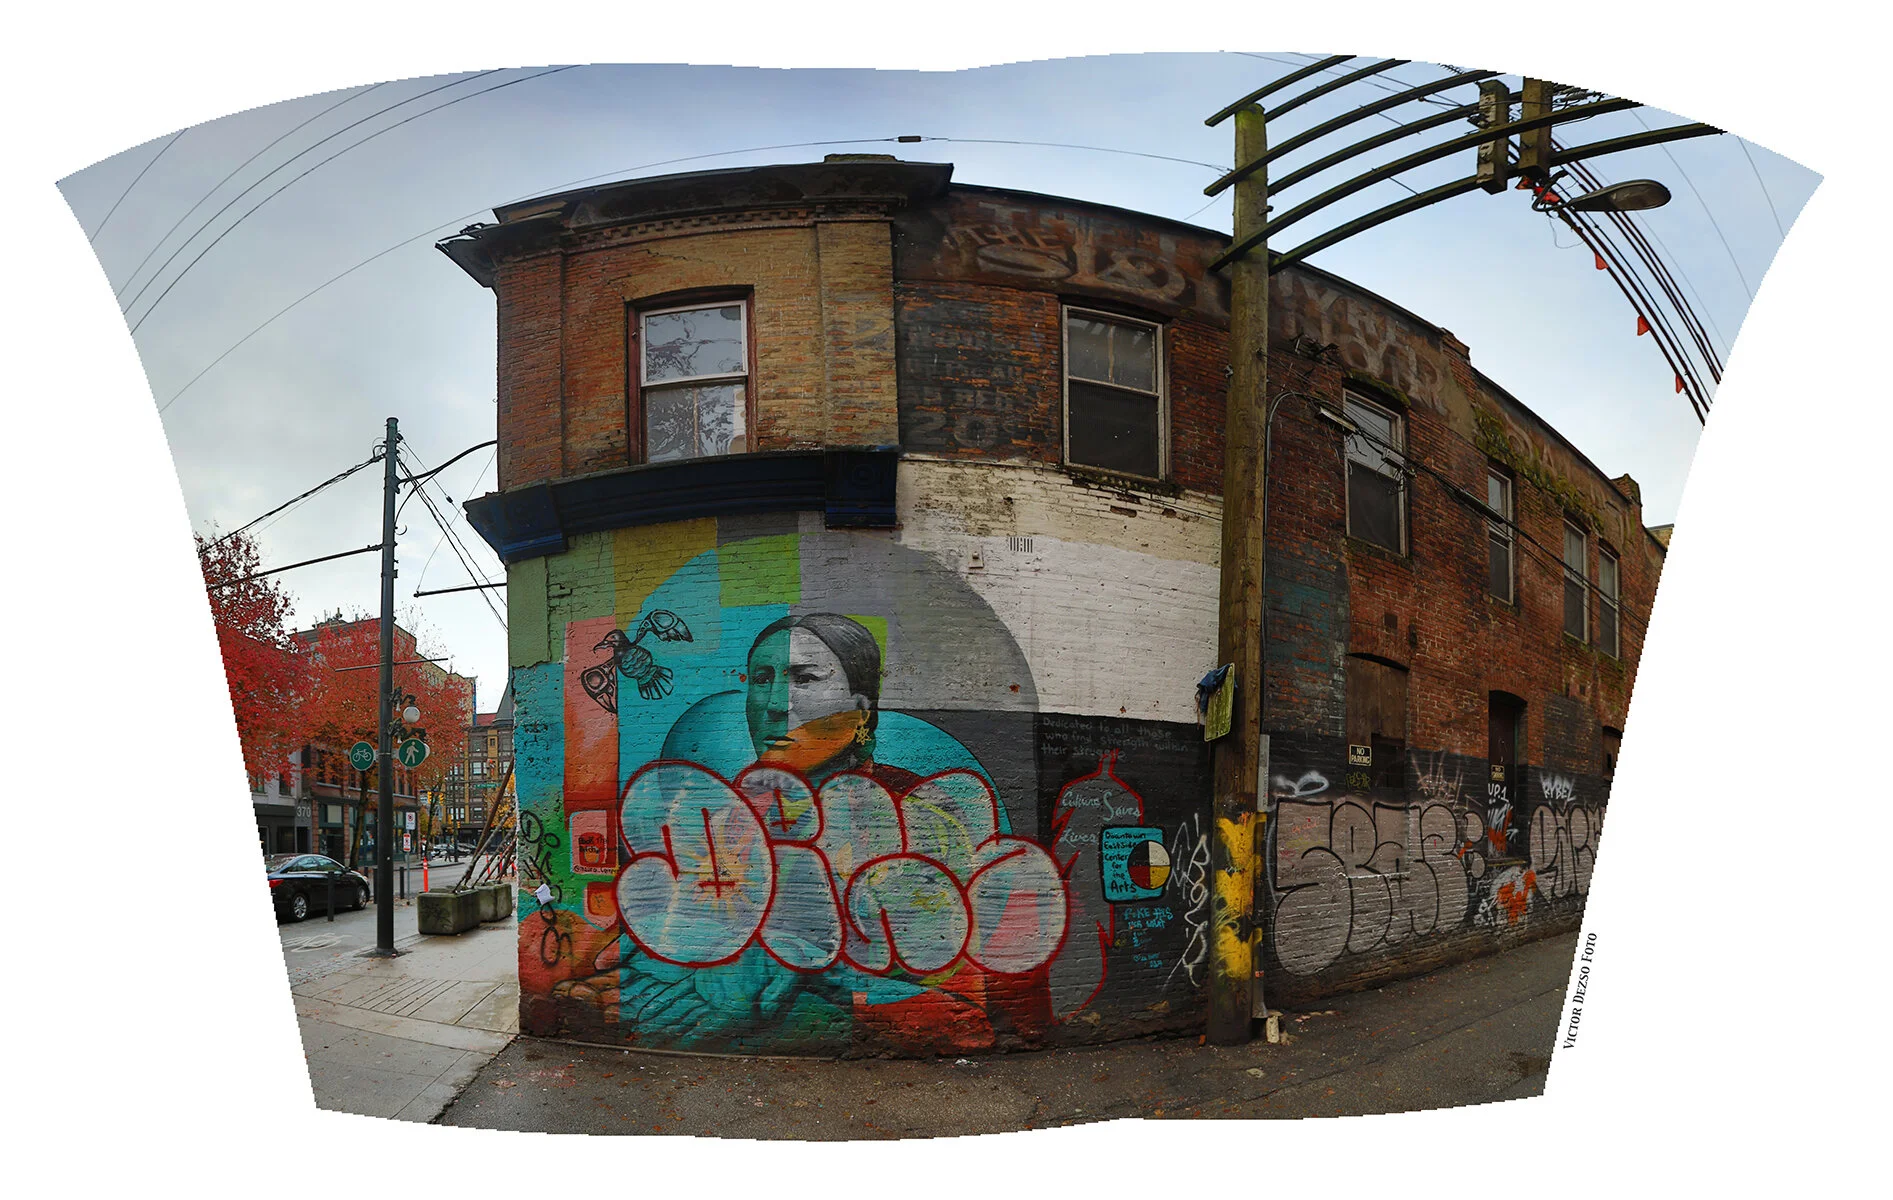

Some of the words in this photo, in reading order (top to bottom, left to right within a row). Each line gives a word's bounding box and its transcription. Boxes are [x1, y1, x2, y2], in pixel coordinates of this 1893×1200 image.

[1042, 717, 1093, 730] Dedicated
[1099, 720, 1110, 732] to
[1114, 723, 1129, 734] all
[1138, 724, 1173, 738] those
[1041, 743, 1067, 756] their
[1356, 747, 1365, 755] NO
[1351, 754, 1370, 764] PARKING
[296, 806, 311, 818] 370
[1102, 791, 1142, 822] Saves
[1059, 828, 1097, 848] Lives
[1105, 831, 1146, 840] Downtown
[1104, 853, 1128, 861] Center
[1111, 862, 1122, 870] for
[1112, 872, 1125, 880] the
[1110, 880, 1137, 893] Arts
